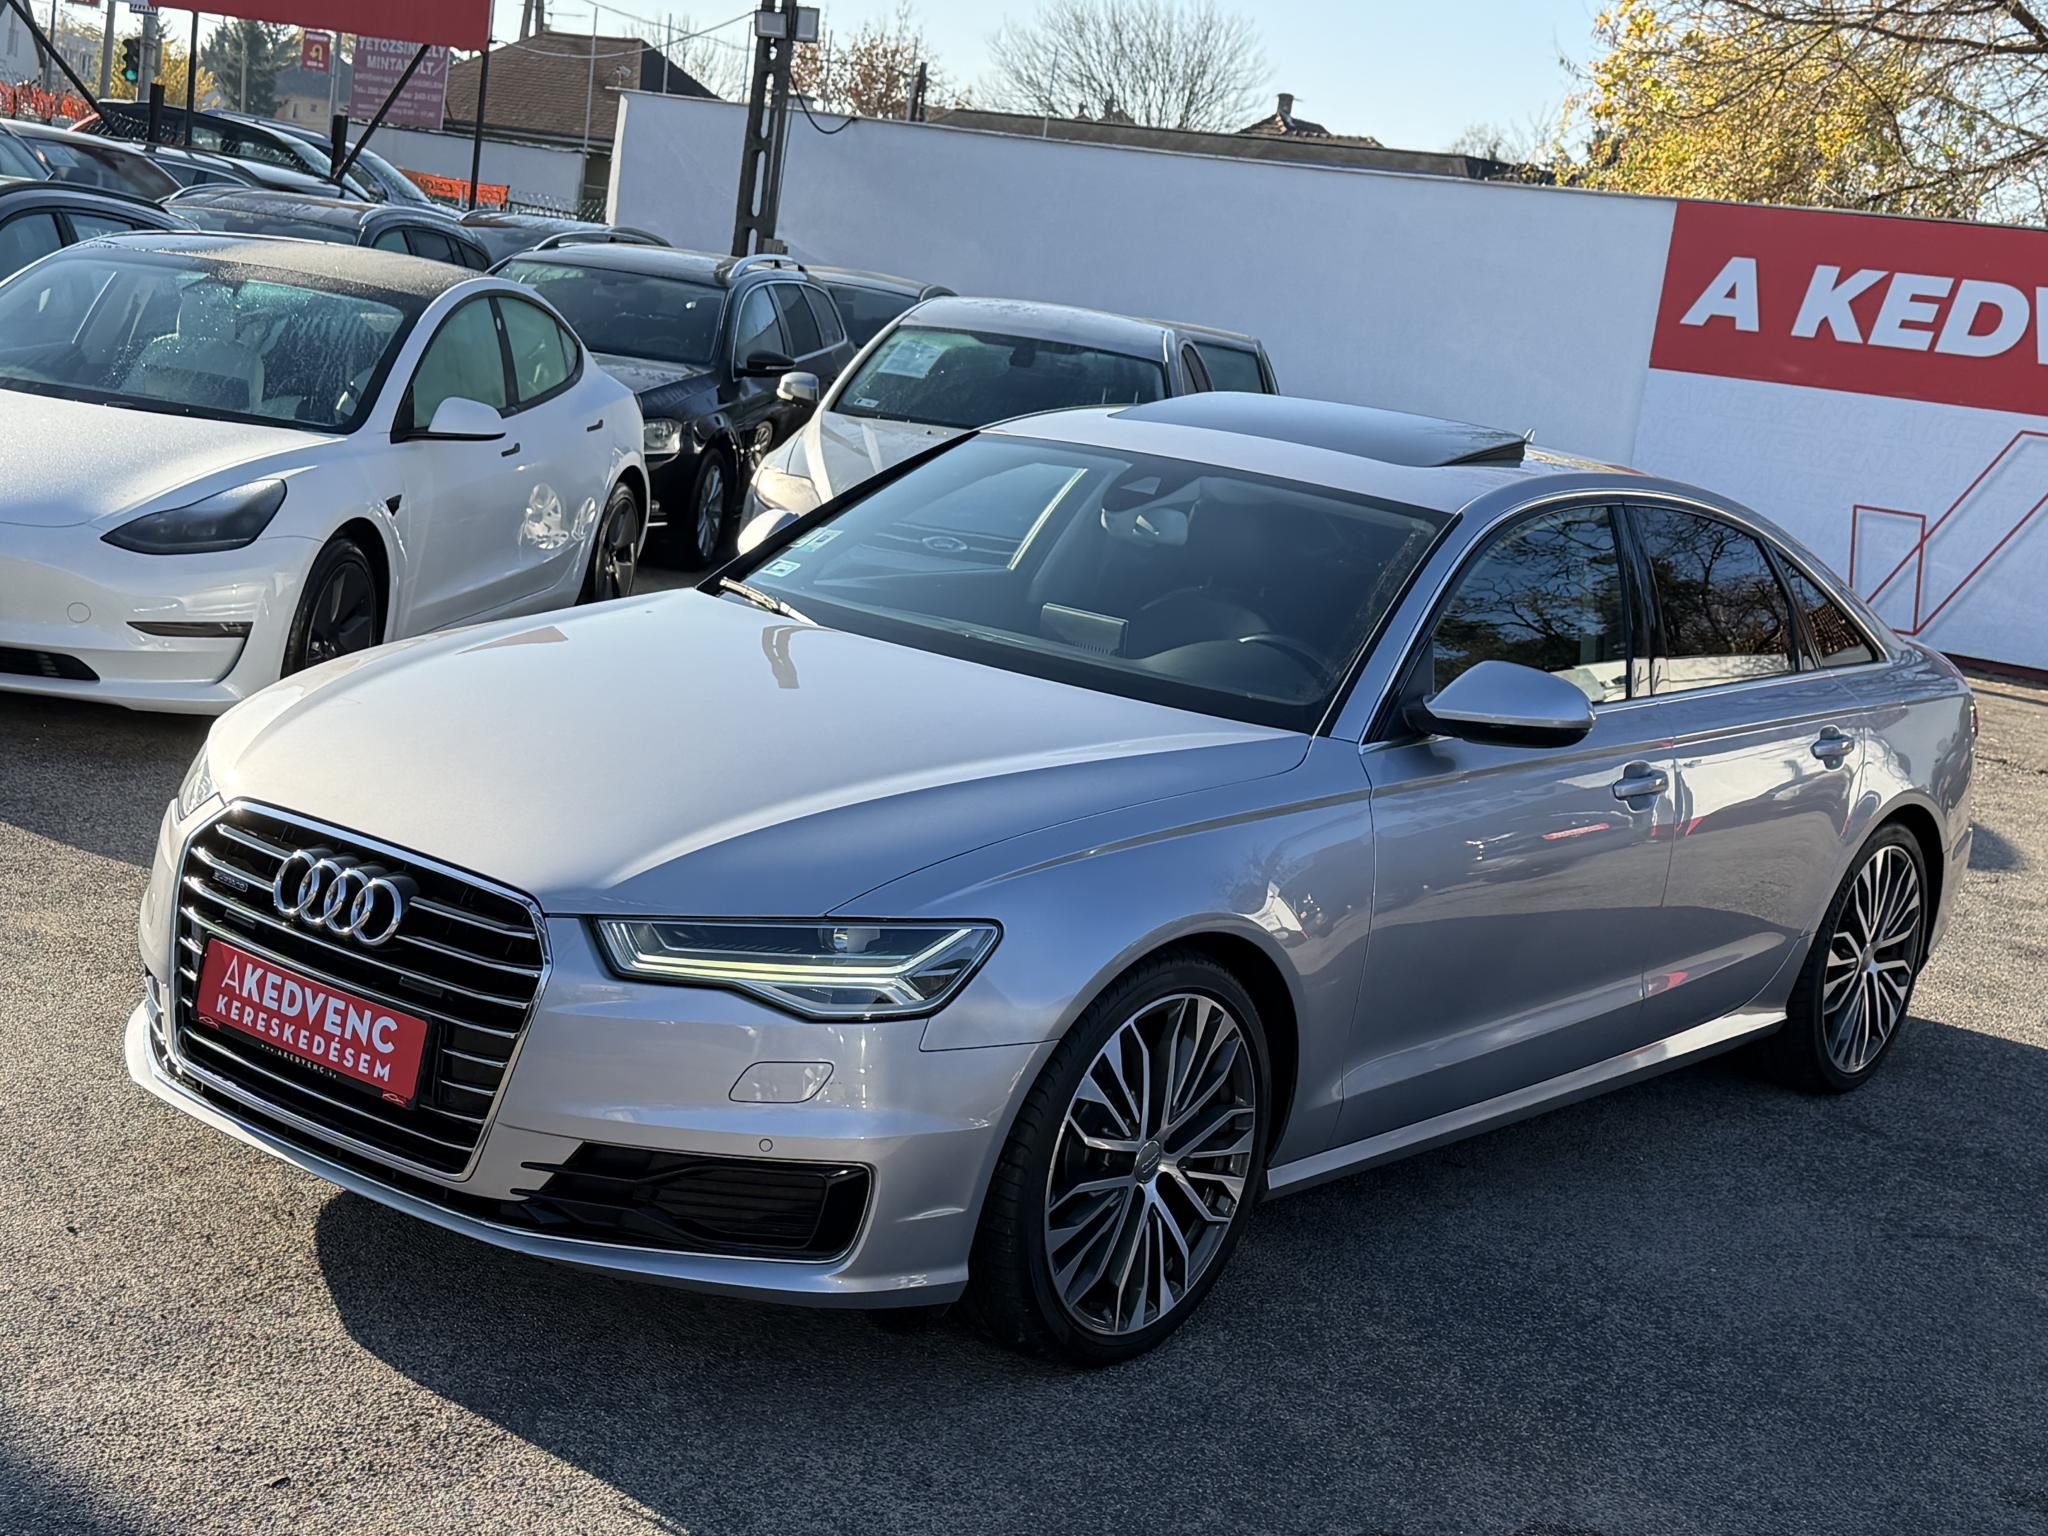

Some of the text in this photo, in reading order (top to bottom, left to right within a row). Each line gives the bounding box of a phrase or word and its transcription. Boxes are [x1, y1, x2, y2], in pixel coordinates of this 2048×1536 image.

[1680, 256, 2048, 364] A KED
[216, 993, 391, 1083] KERESKEDÉSEM
